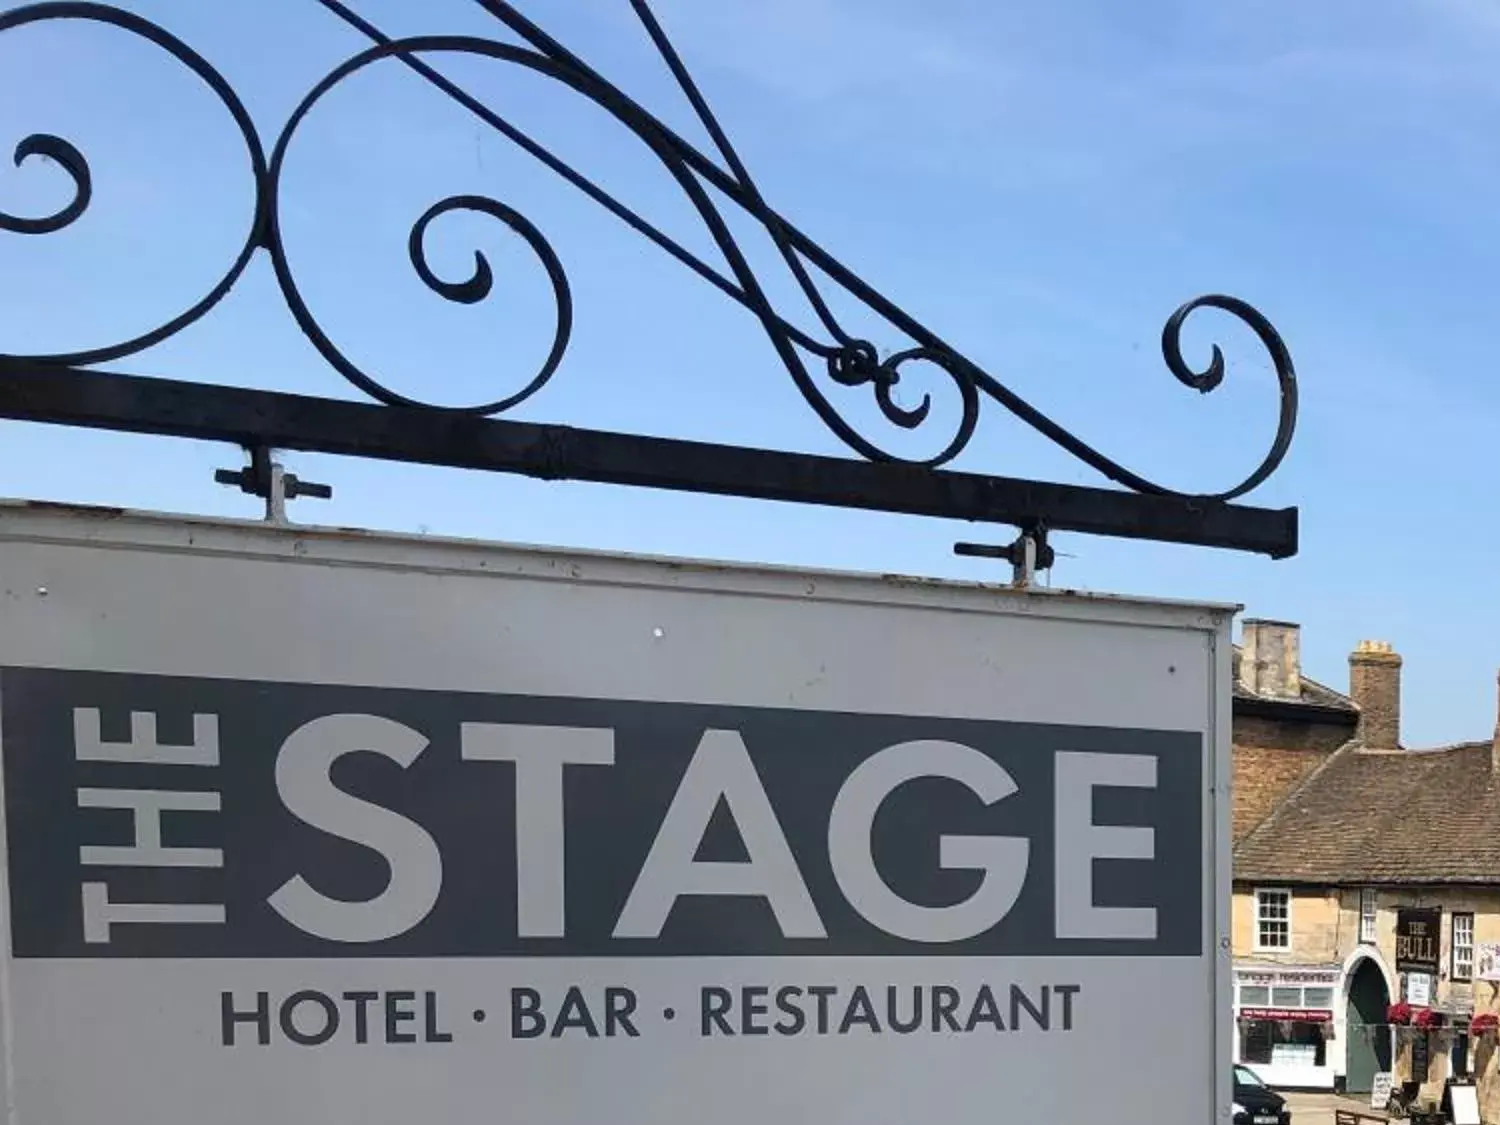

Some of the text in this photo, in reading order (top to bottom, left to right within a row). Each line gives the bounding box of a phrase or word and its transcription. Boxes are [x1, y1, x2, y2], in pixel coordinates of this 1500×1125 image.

[73, 706, 226, 944] THE
[267, 712, 1159, 944] STAGE
[1397, 936, 1436, 961] BULL
[1408, 921, 1427, 935] THE
[220, 983, 1081, 1047] HOTEL BAR RESTAURANT
